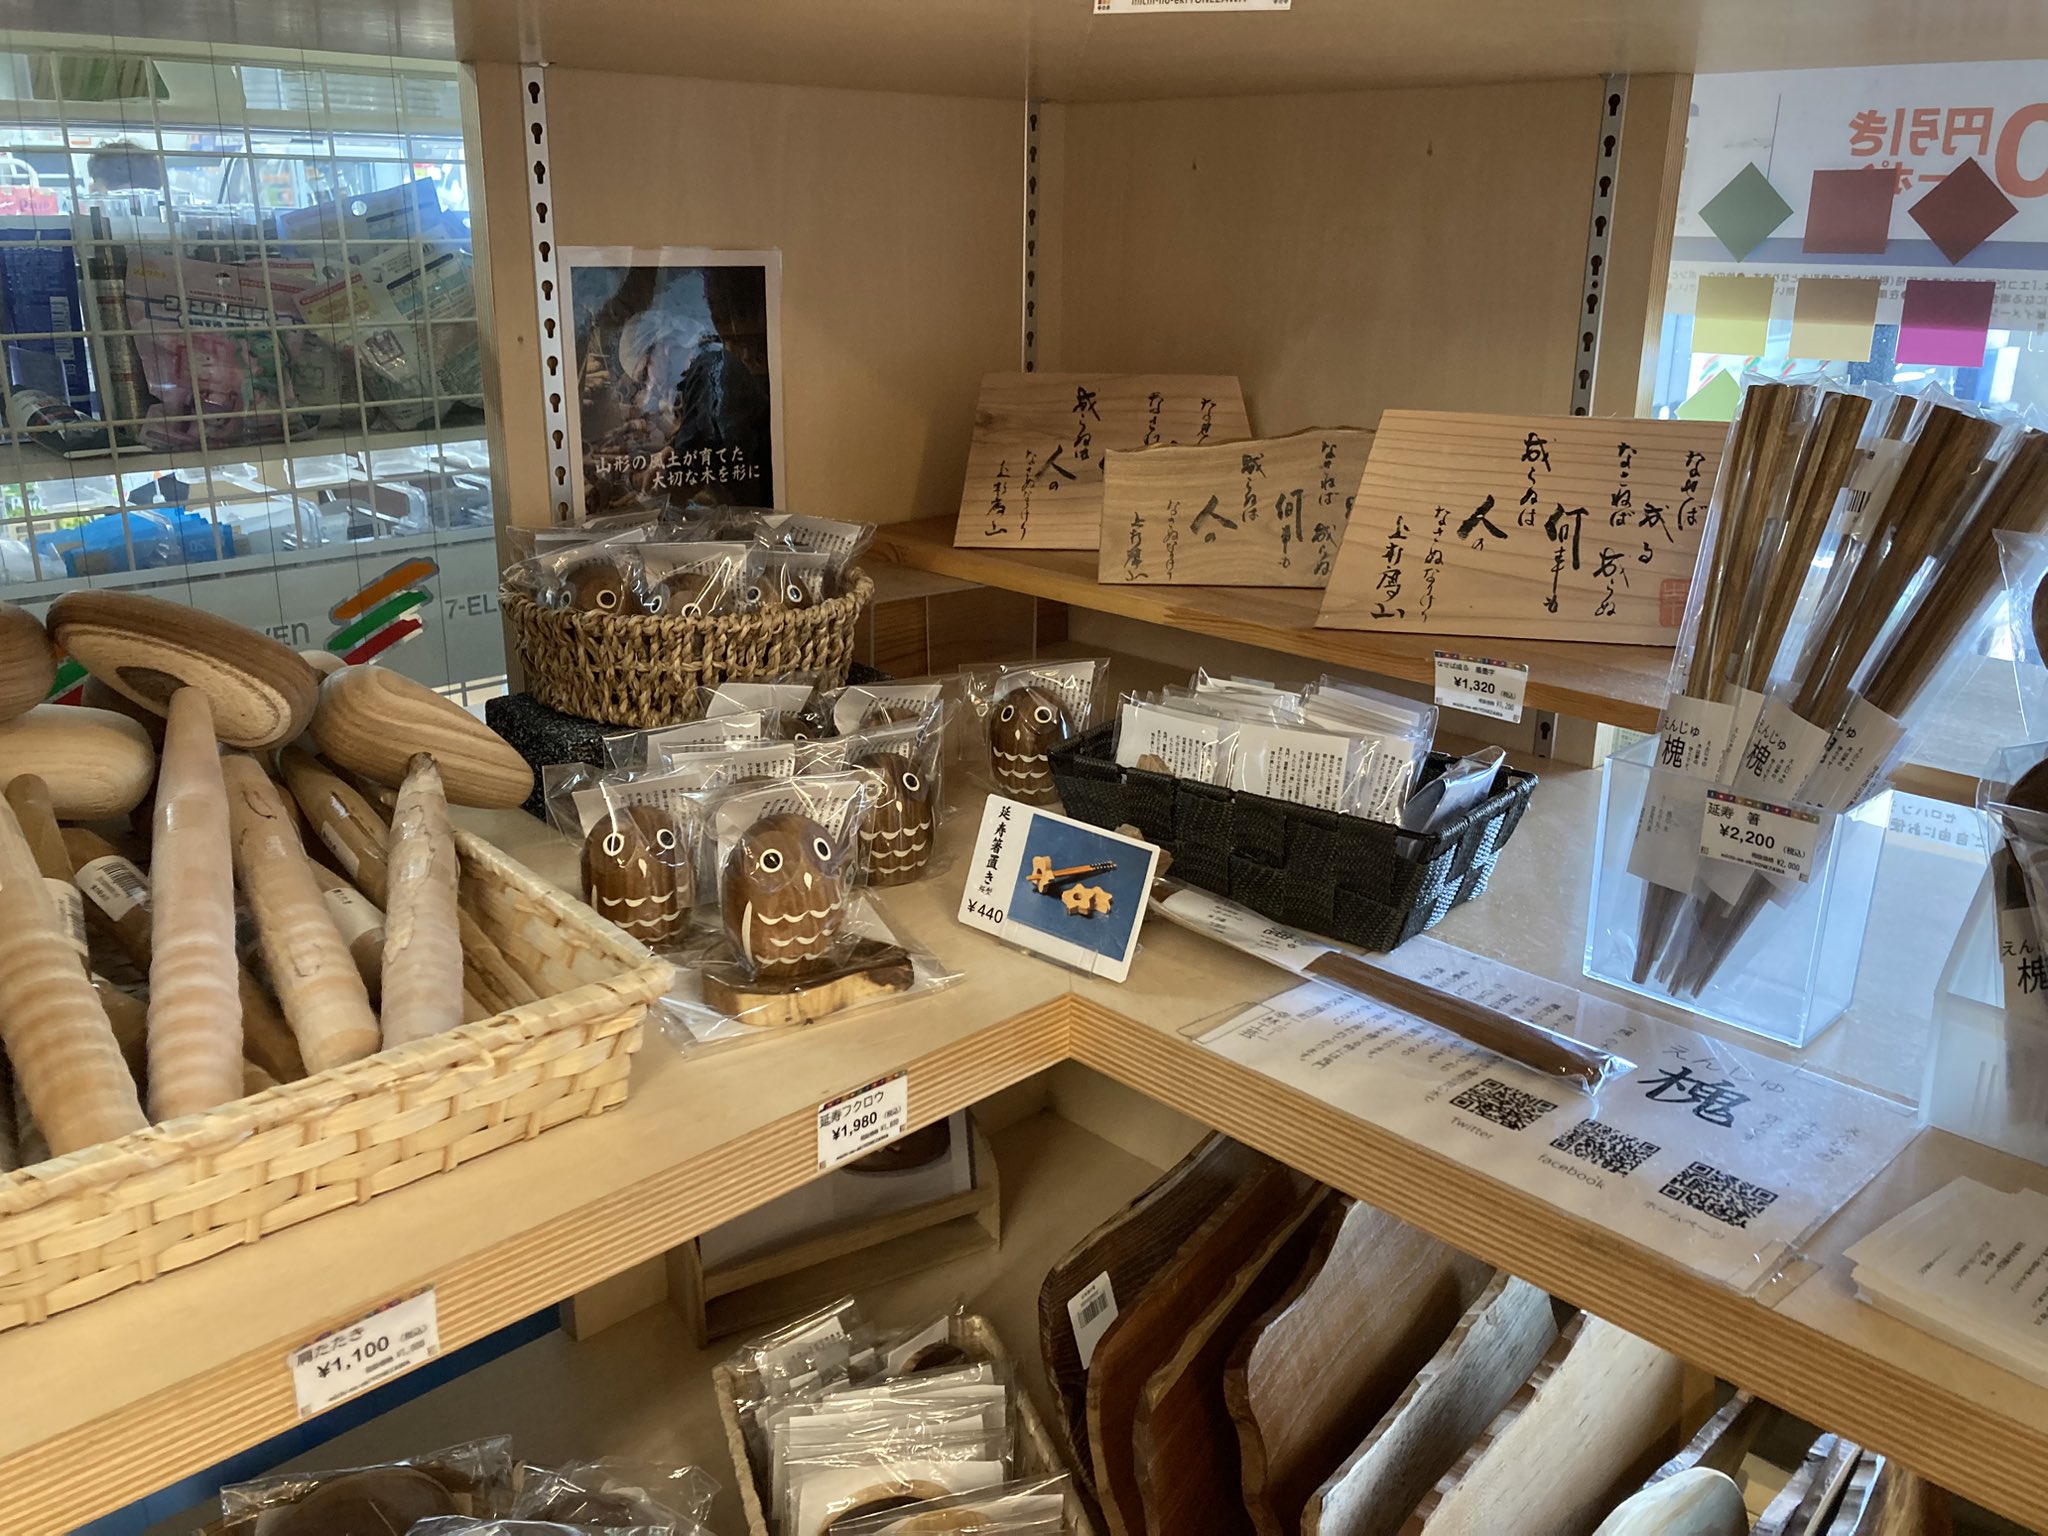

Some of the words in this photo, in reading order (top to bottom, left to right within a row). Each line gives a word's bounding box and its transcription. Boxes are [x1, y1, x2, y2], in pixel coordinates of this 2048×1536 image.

[596, 446, 744, 474] 山形の風土が育てた
[652, 464, 760, 490] 大切な木を形に
[1454, 676, 1496, 695] ¥1,320
[1707, 802, 1735, 820] 延寿
[1720, 823, 1775, 849] ¥2,200
[967, 898, 1004, 923] ¥440
[832, 1111, 878, 1141] ¥1,980
[1449, 1116, 1494, 1141] Twitter
[1537, 1153, 1606, 1191] facebook
[317, 1336, 390, 1378] ¥1,100
